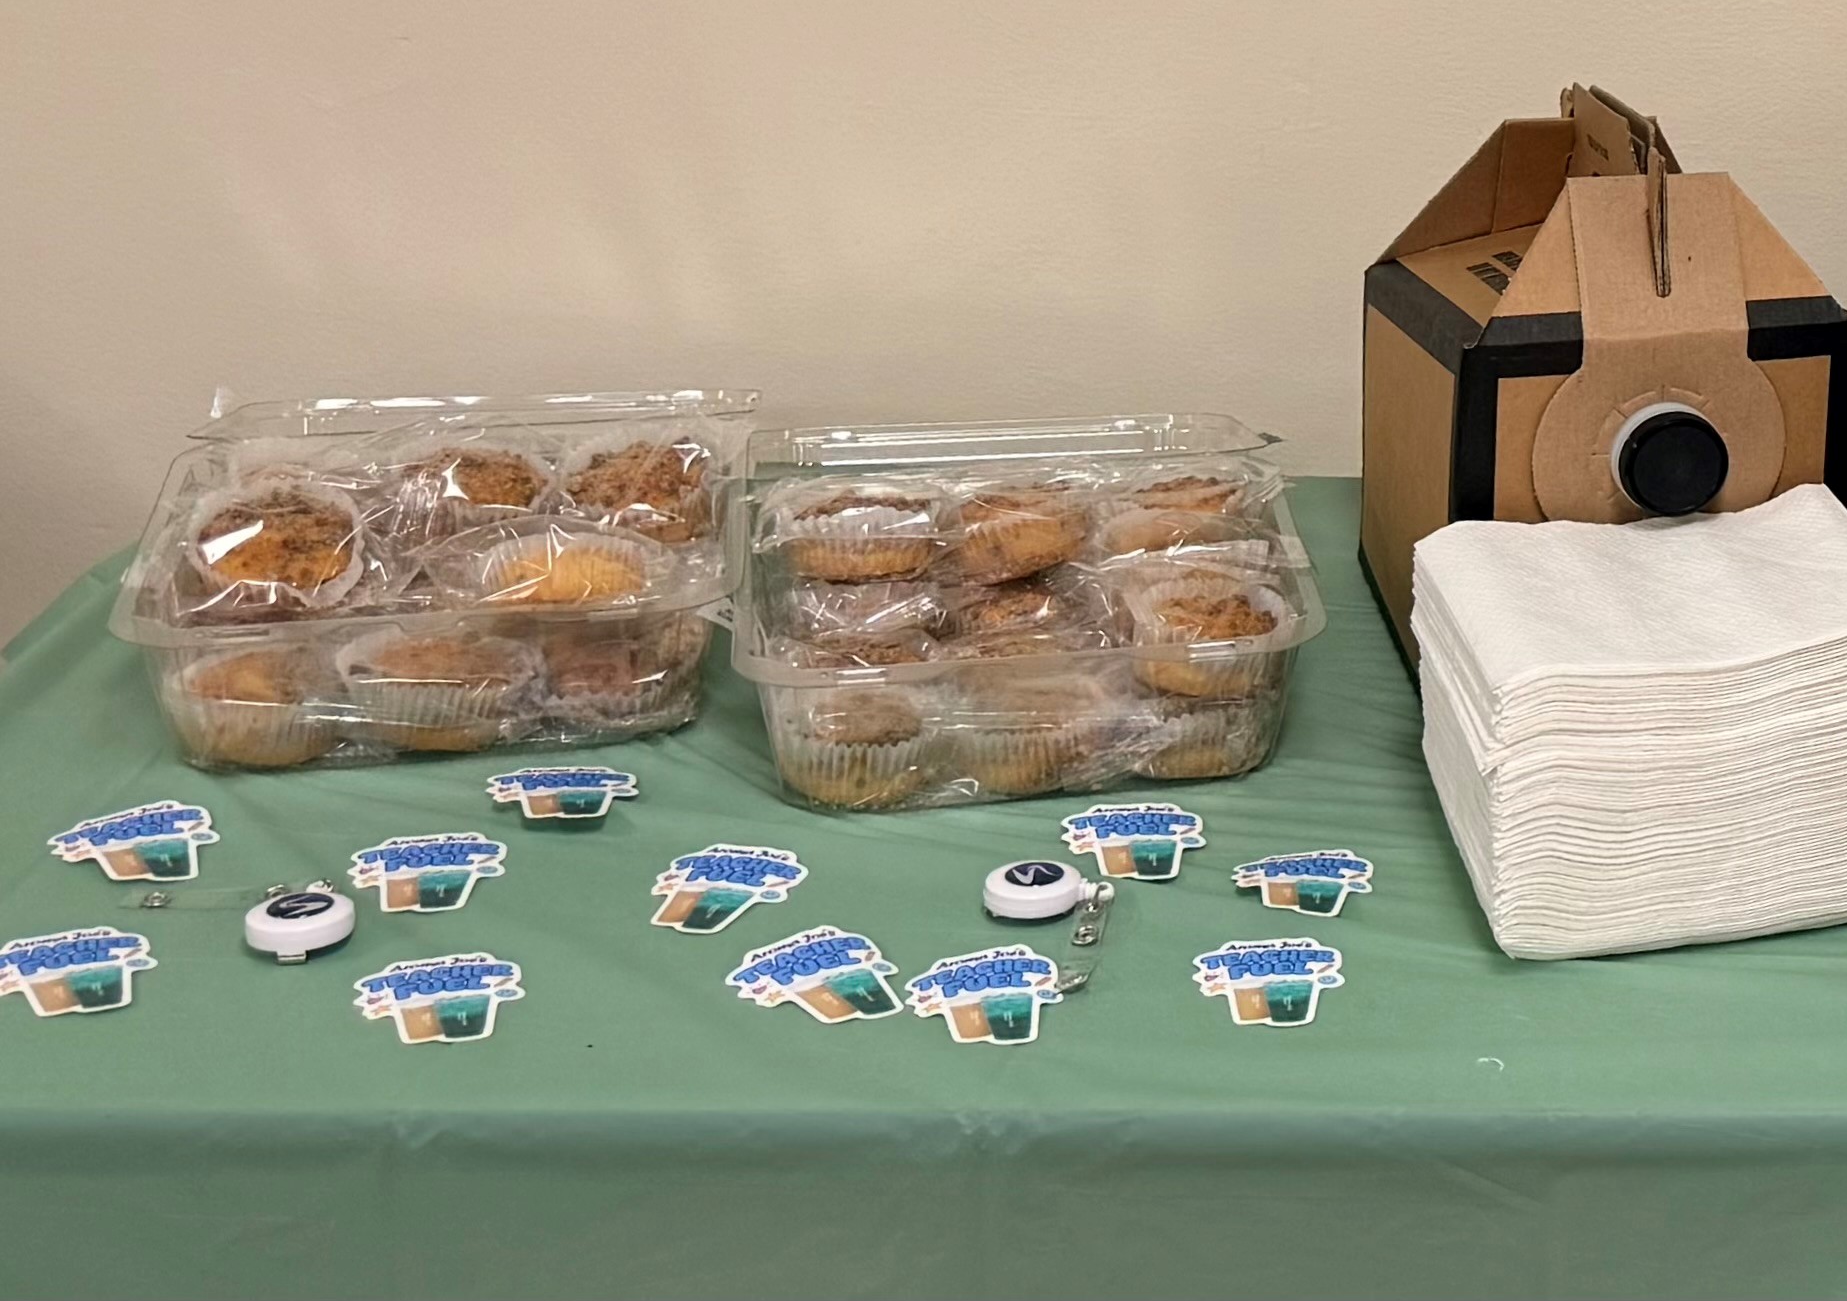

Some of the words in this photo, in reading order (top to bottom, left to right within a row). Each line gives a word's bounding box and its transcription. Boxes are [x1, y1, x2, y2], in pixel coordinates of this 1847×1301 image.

[53, 809, 203, 844] TEACHER
[1070, 813, 1198, 829] TEACHER
[1095, 822, 1178, 839] FUEL
[88, 821, 186, 846] FUEL
[358, 842, 500, 864] TEACHER
[384, 853, 475, 872] FUEL
[675, 855, 802, 880] TEACHER
[685, 867, 766, 887] FUEL
[733, 937, 872, 984] TEACHER
[771, 953, 862, 986] FUEL
[1200, 950, 1336, 971] TEACHER
[1229, 961, 1314, 980] FUEL
[361, 964, 515, 993] TEACHER
[911, 958, 1052, 992] TEACHER
[942, 972, 1032, 998] FUEL
[393, 979, 491, 1001] FUEL
